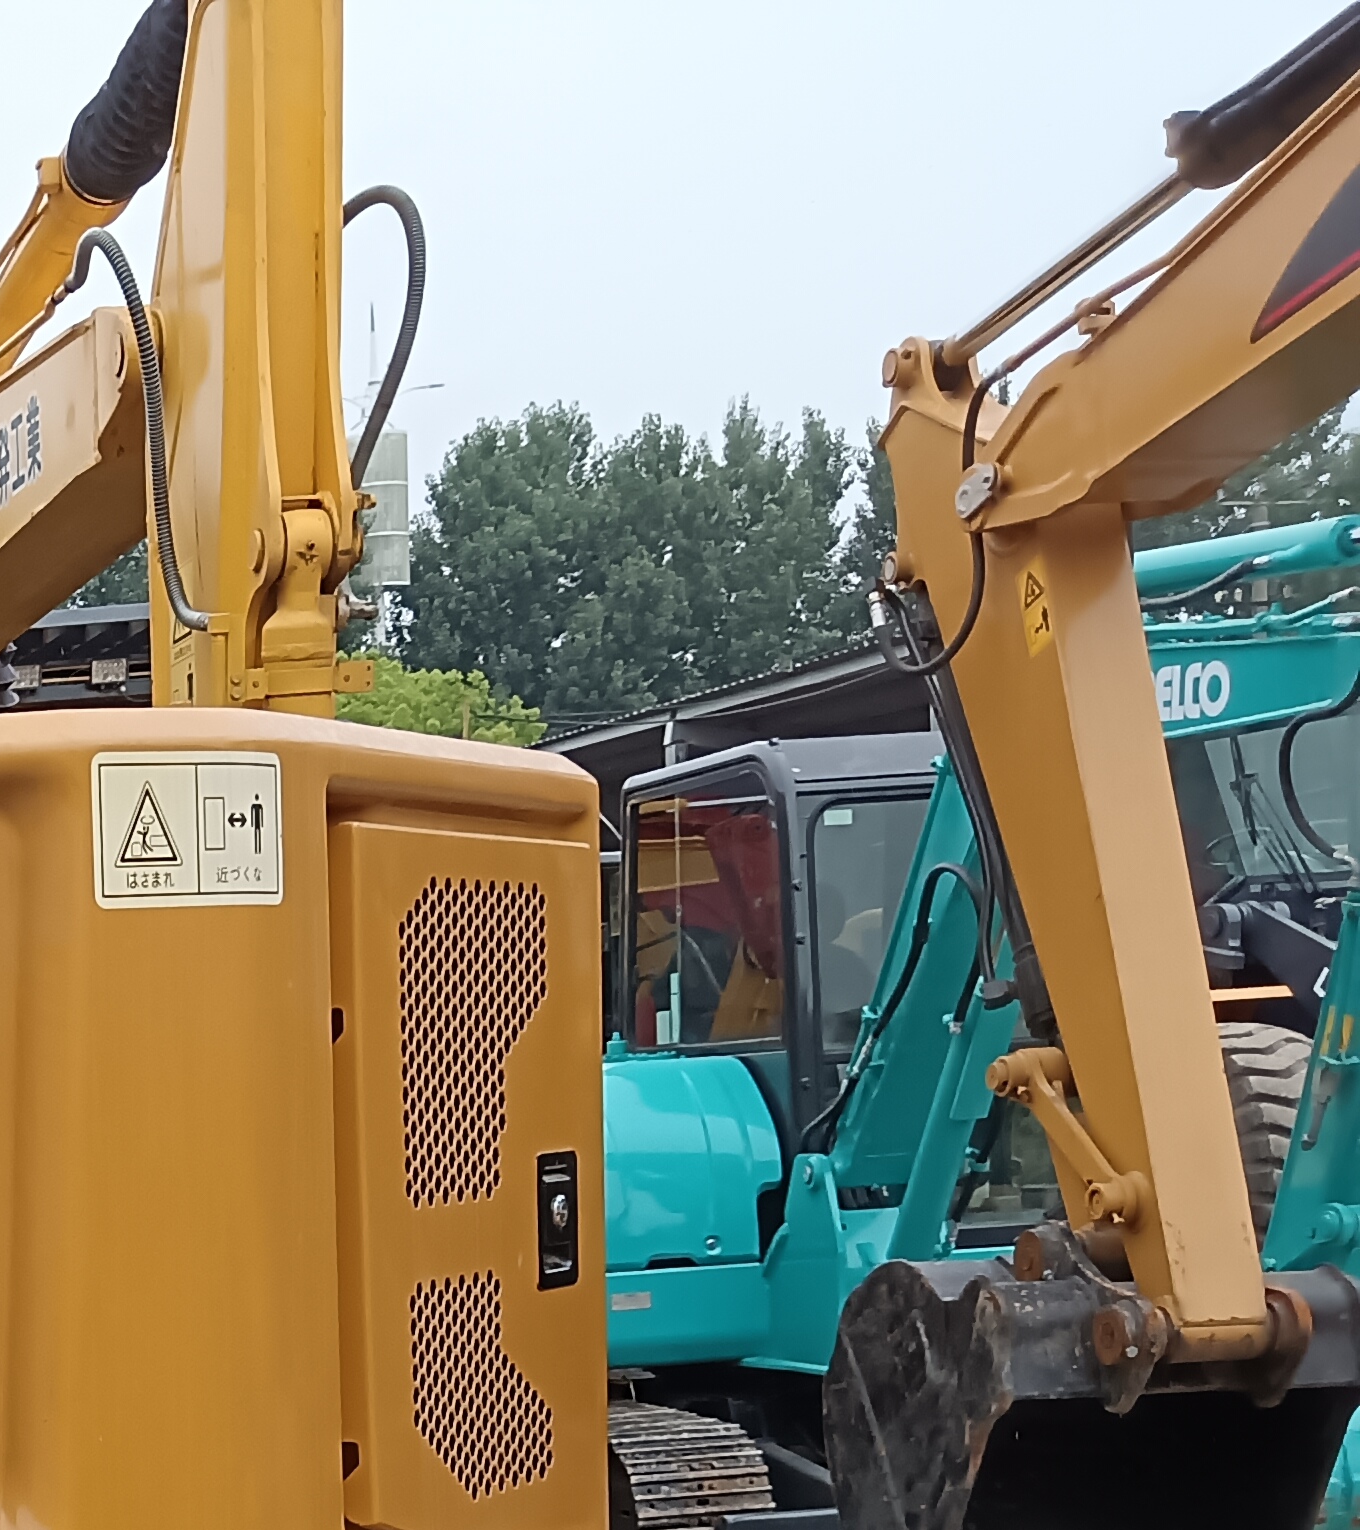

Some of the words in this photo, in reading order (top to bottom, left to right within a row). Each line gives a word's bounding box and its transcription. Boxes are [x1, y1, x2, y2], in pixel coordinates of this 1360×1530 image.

[1152, 660, 1230, 722] ELCO
[126, 871, 175, 889] はさまれ
[215, 866, 263, 884] 近づくな
